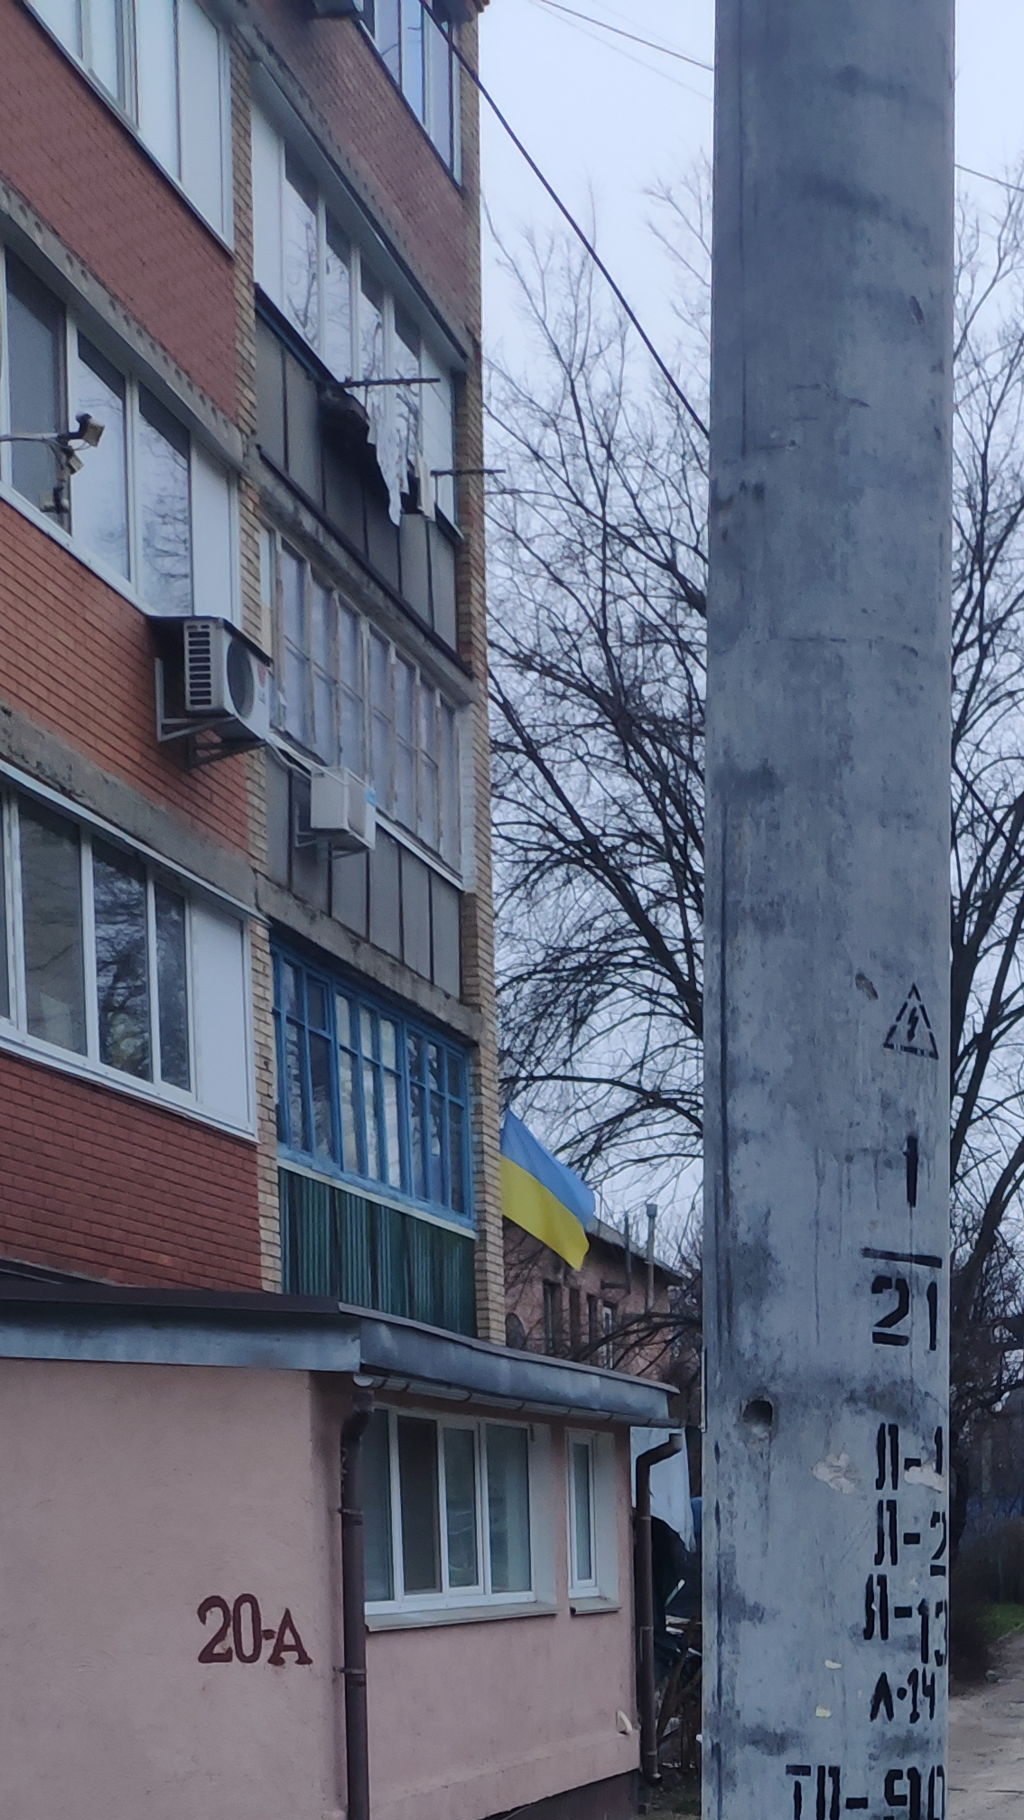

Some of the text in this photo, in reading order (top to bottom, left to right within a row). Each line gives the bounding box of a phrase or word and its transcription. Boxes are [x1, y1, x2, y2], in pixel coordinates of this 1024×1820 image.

[903, 1134, 918, 1208] 1
[871, 1275, 938, 1351] 21
[197, 1593, 313, 1666] 20-А
